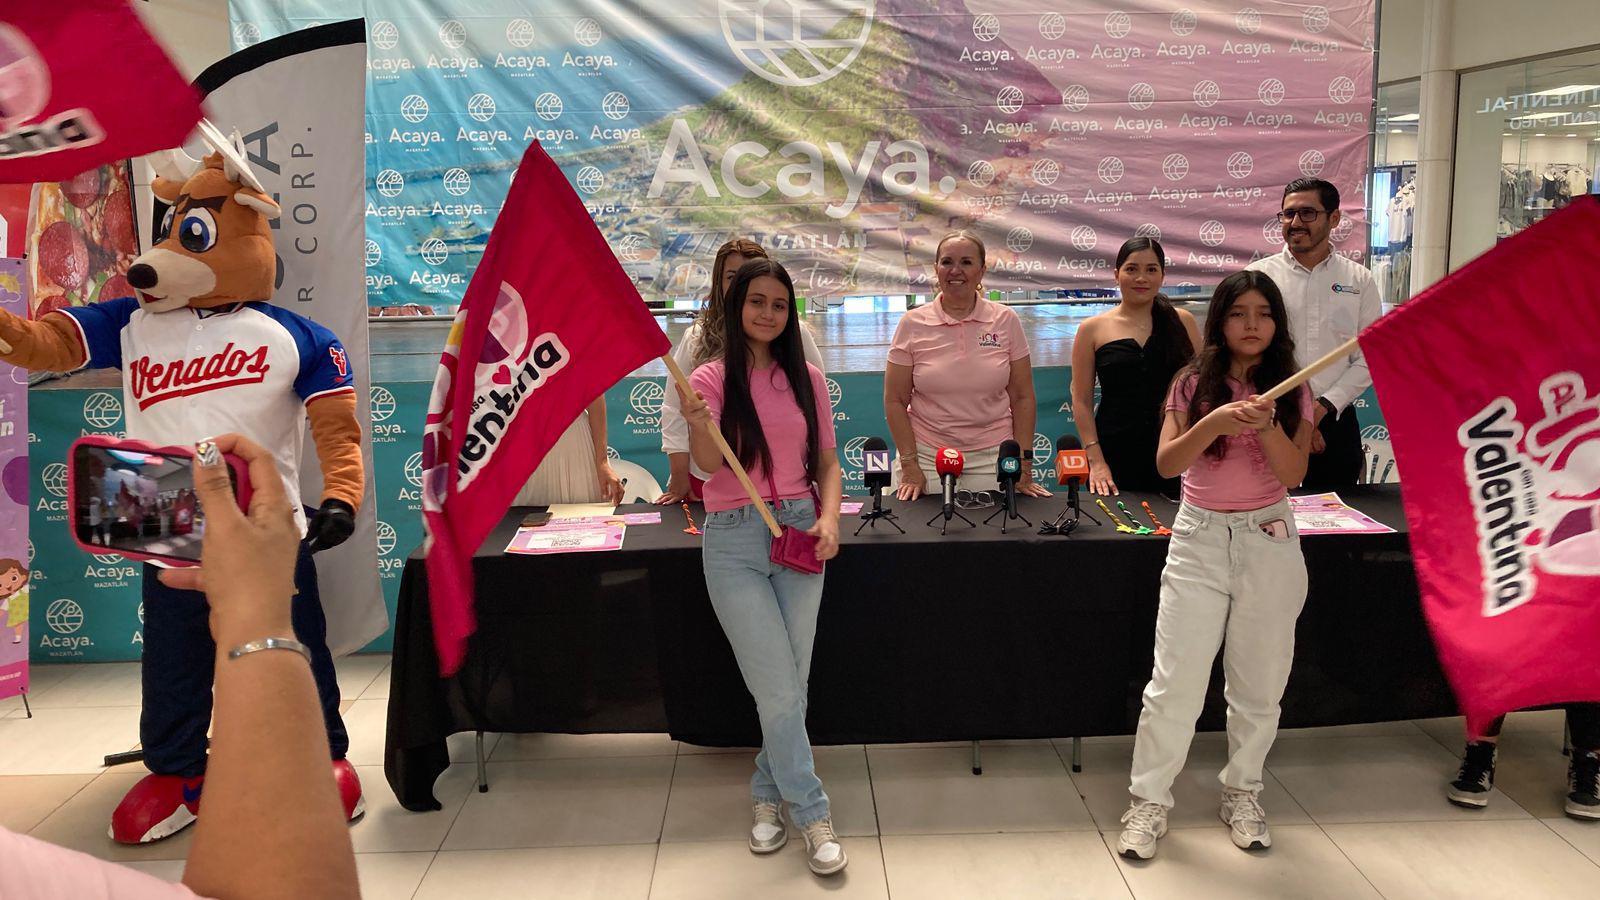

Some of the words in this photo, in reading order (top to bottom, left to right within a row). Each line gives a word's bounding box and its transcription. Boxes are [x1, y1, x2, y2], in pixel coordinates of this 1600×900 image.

[959, 47, 1014, 64] Acaya.
[1025, 45, 1080, 63] Acaya.
[1091, 44, 1145, 61] Acaya.
[1156, 41, 1210, 59] Acaya.
[1221, 39, 1276, 57] Acaya.
[1288, 38, 1343, 56] Acaya.
[426, 53, 483, 72] Acaya.
[495, 52, 550, 71] Acaya.
[562, 51, 618, 70] Acaya.
[1049, 118, 1103, 135] Acaya.
[1114, 115, 1167, 133] Acaya.
[1179, 113, 1232, 130] Acaya.
[1243, 111, 1297, 129] Acaya.
[1313, 110, 1367, 126] Acaya.
[456, 127, 512, 145] Acaya.
[523, 126, 579, 145] Acaya.
[590, 125, 645, 142] Acaya.
[983, 119, 1037, 137] Acaya.
[389, 128, 445, 146] Acaya.
[647, 118, 957, 218] Acaya.
[291, 127, 318, 255] CORP.
[1019, 191, 1073, 208] Acaya.
[1084, 189, 1137, 206] Acaya.
[1148, 186, 1202, 203] Acaya.
[1213, 184, 1266, 201] Acaya.
[365, 203, 420, 219] Acaya.
[432, 201, 487, 218] Acaya.
[750, 230, 868, 248] AZATLÁN
[994, 258, 1046, 274] Acaya.
[1057, 256, 1110, 272] Acaya.
[1187, 252, 1238, 267] Acaya.
[366, 274, 398, 289] aya.
[409, 270, 465, 287] Acaya.
[130, 342, 270, 399] Venados
[624, 414, 662, 427] Acay
[372, 424, 406, 437] aya.
[841, 468, 864, 480] Aca
[1032, 469, 1056, 481] aya
[37, 498, 68, 511] Aca
[1468, 407, 1531, 607] Valentina
[84, 565, 139, 580] Acaya.
[378, 558, 405, 572] aya.
[40, 634, 94, 650] Acaya.
